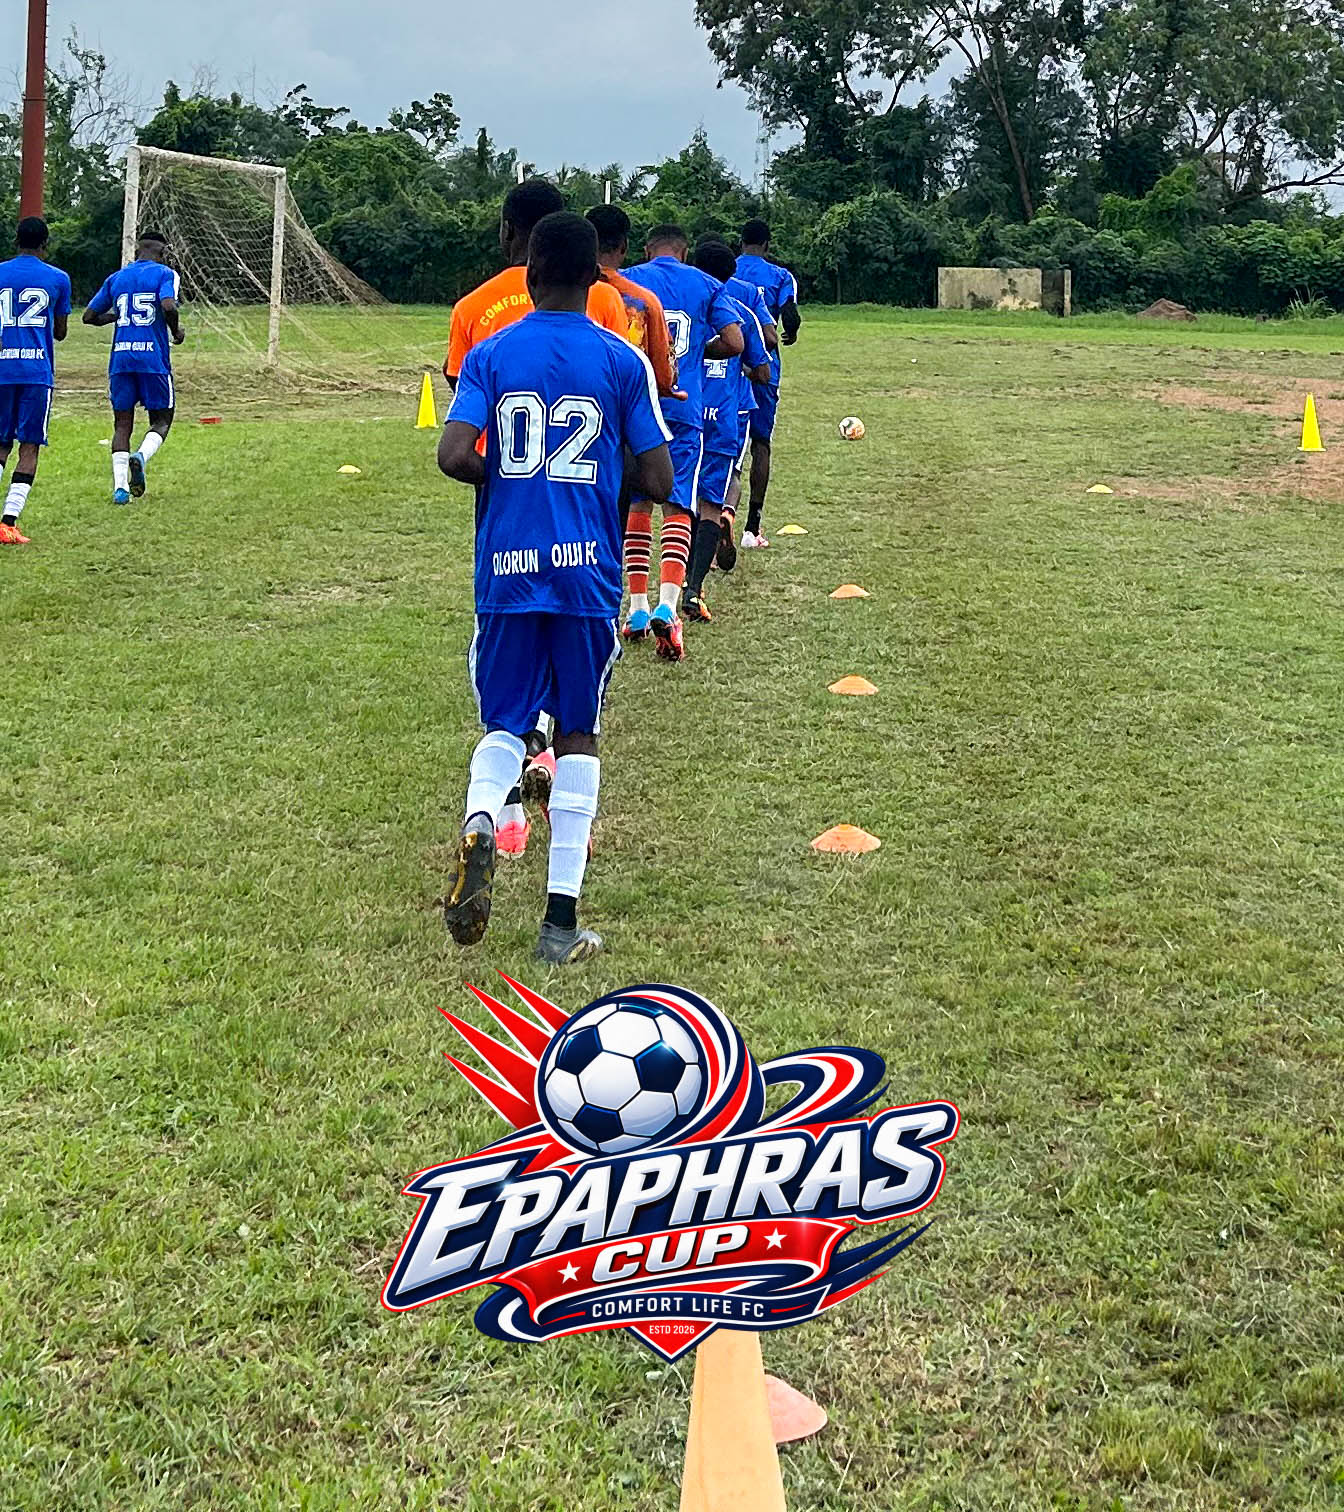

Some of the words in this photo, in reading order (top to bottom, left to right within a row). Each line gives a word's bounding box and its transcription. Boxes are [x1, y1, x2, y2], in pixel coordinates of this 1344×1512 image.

[116, 292, 156, 327] 15
[479, 293, 534, 326] COMFOR
[496, 391, 603, 485] 02
[493, 548, 539, 576] OLORUN
[551, 542, 583, 568] OJIJI
[585, 540, 598, 566] FC
